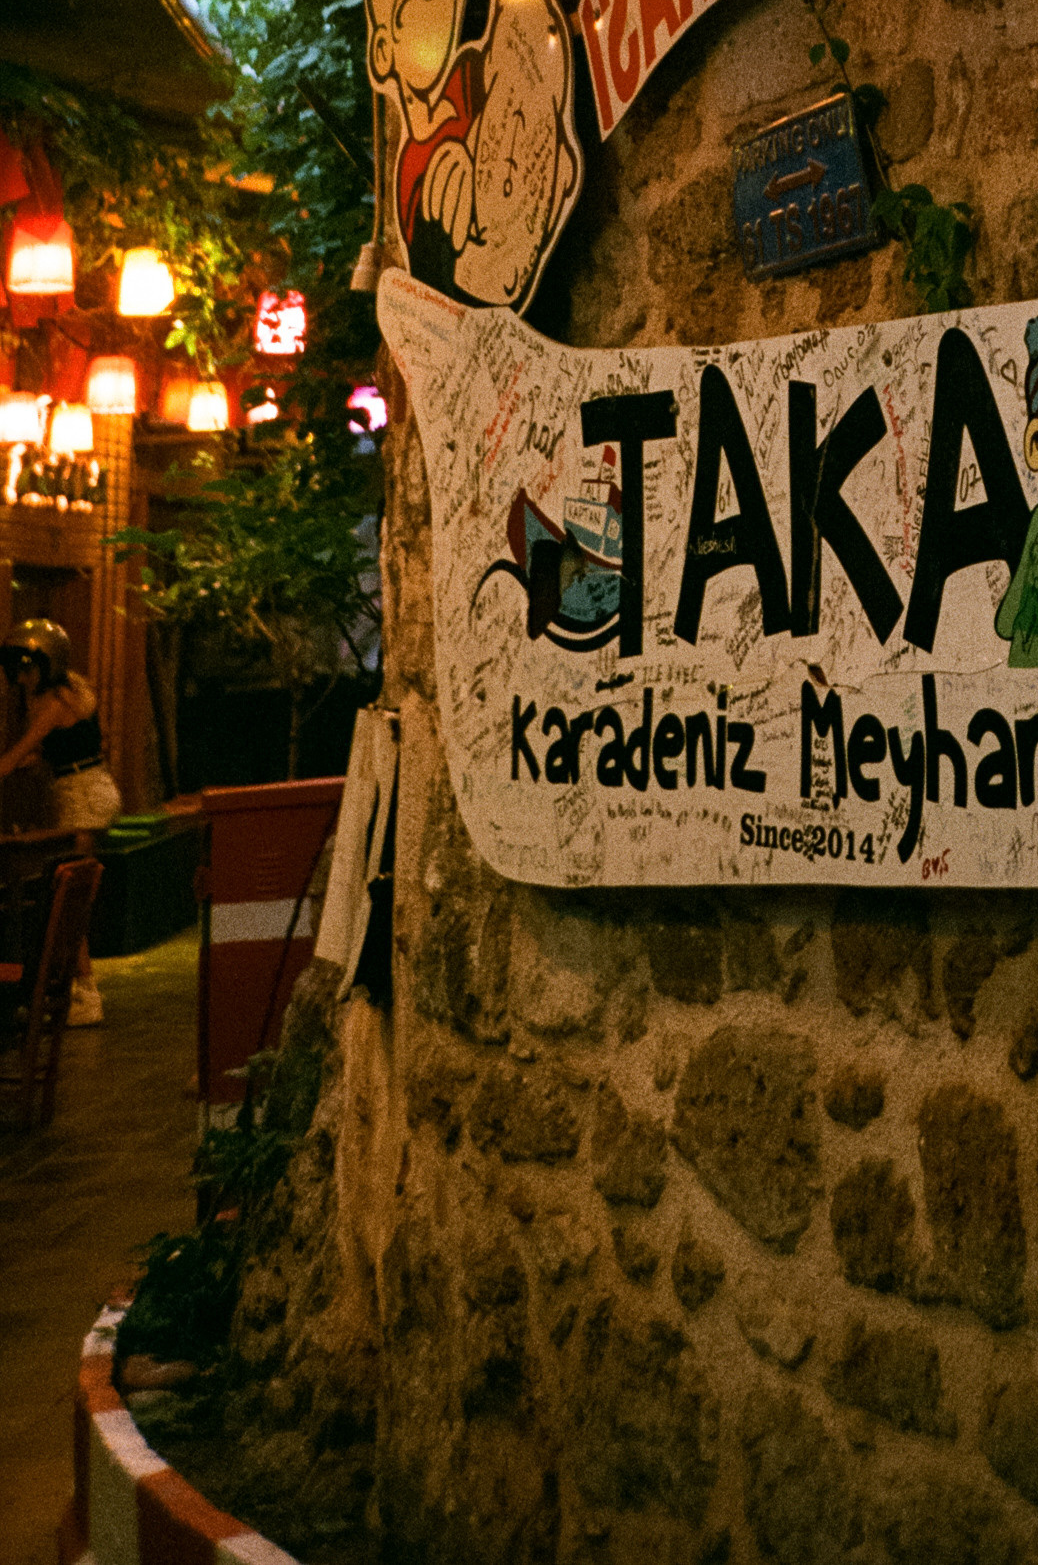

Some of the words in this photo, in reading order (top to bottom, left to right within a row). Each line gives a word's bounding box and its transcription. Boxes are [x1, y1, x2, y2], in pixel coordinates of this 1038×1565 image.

[769, 202, 804, 260] TS
[807, 182, 865, 244] 1967
[581, 327, 1032, 657] TAKA
[717, 479, 732, 515] 61
[511, 687, 767, 795] Karadeniz
[740, 812, 805, 855] Since
[811, 823, 875, 865] 2014
